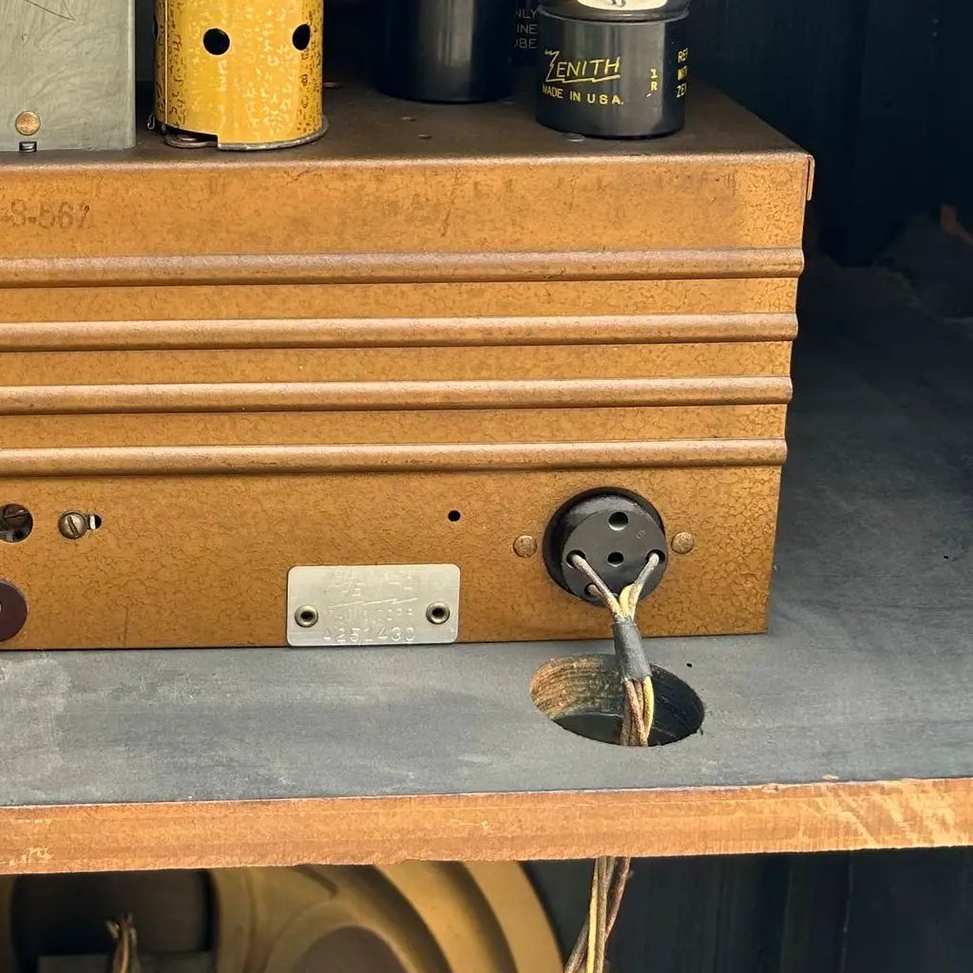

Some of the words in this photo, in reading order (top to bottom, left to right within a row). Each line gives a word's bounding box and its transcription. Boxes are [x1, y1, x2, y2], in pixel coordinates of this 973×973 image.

[545, 49, 621, 83] ZENITH
[542, 84, 564, 99] MADE
[569, 91, 581, 102] IN
